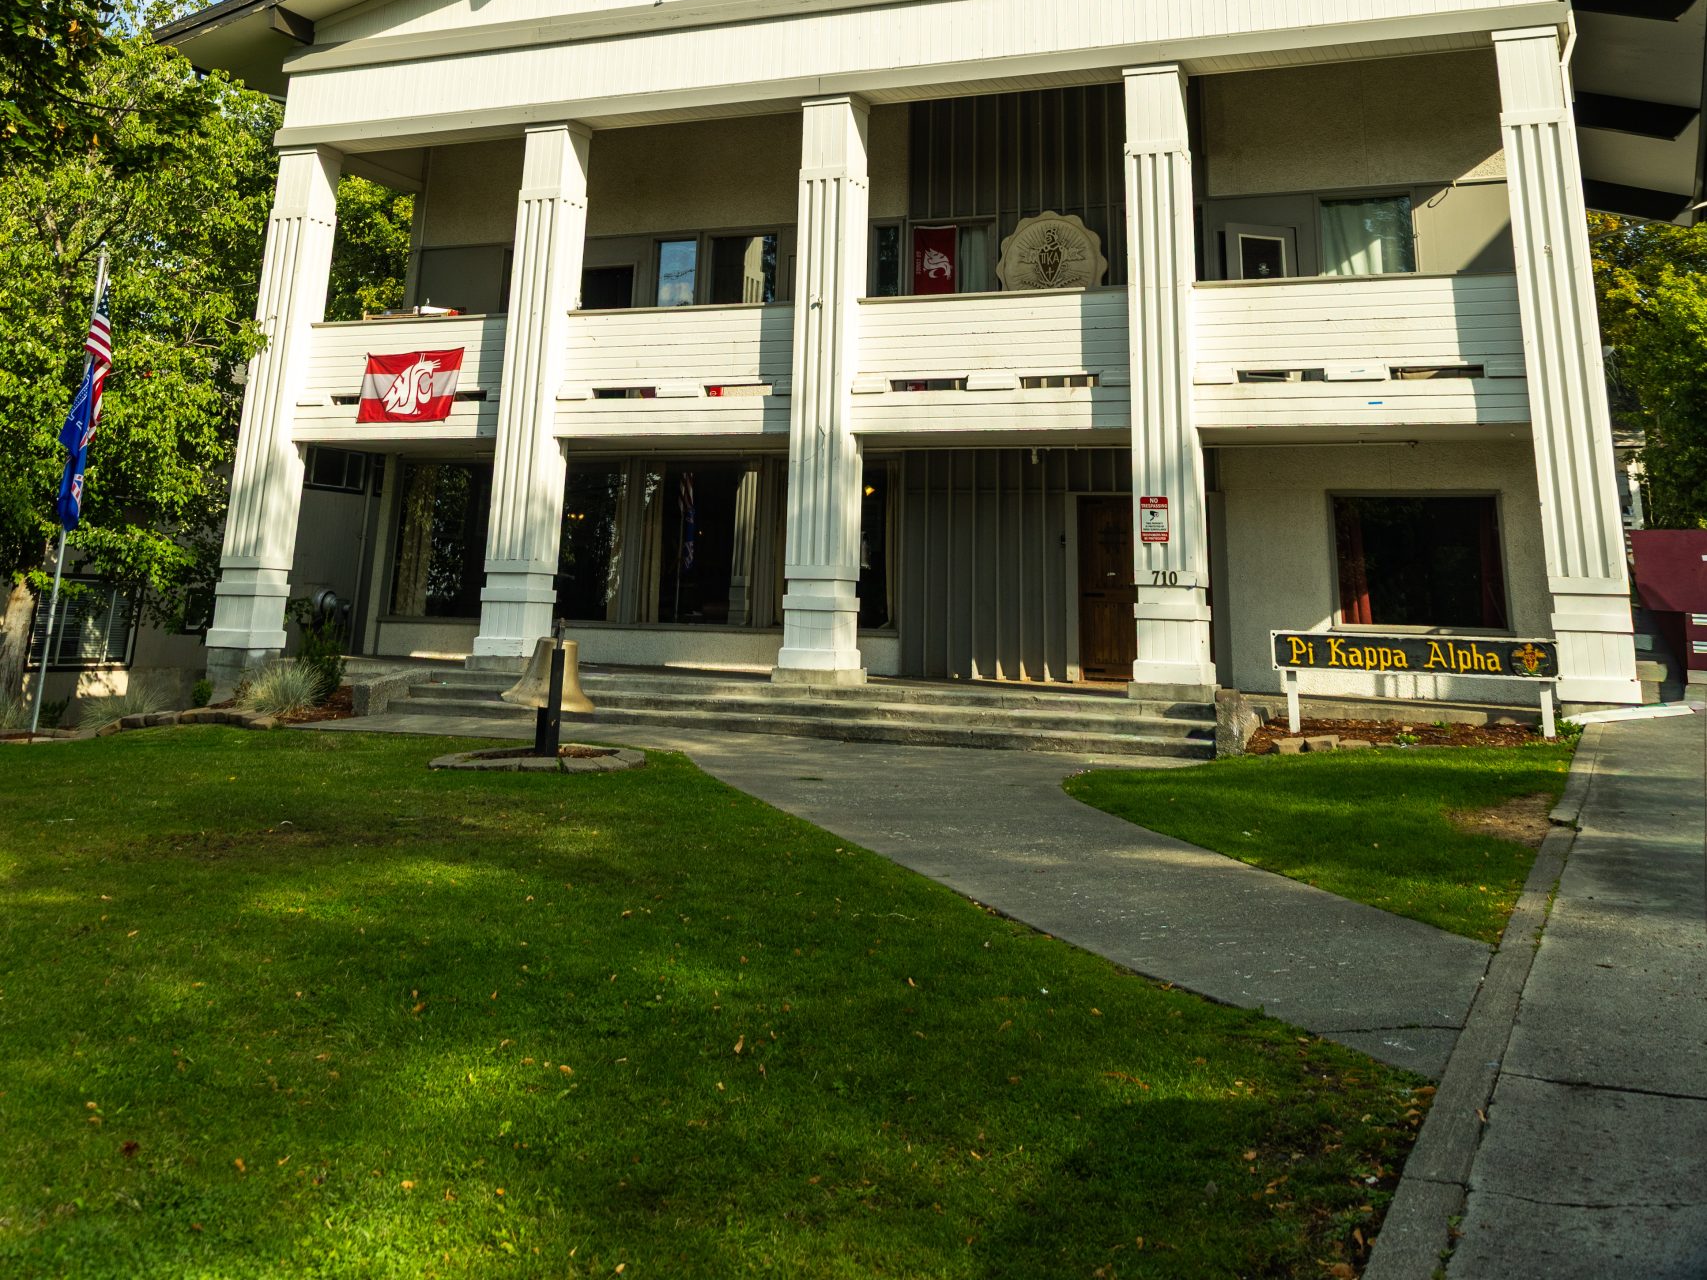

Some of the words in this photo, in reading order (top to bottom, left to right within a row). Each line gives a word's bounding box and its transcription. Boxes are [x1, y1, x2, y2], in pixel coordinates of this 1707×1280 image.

[1151, 570, 1178, 586] 710
[1286, 635, 1315, 665] Pi
[1326, 637, 1409, 672] Kappa
[1423, 640, 1503, 674] Alpha
